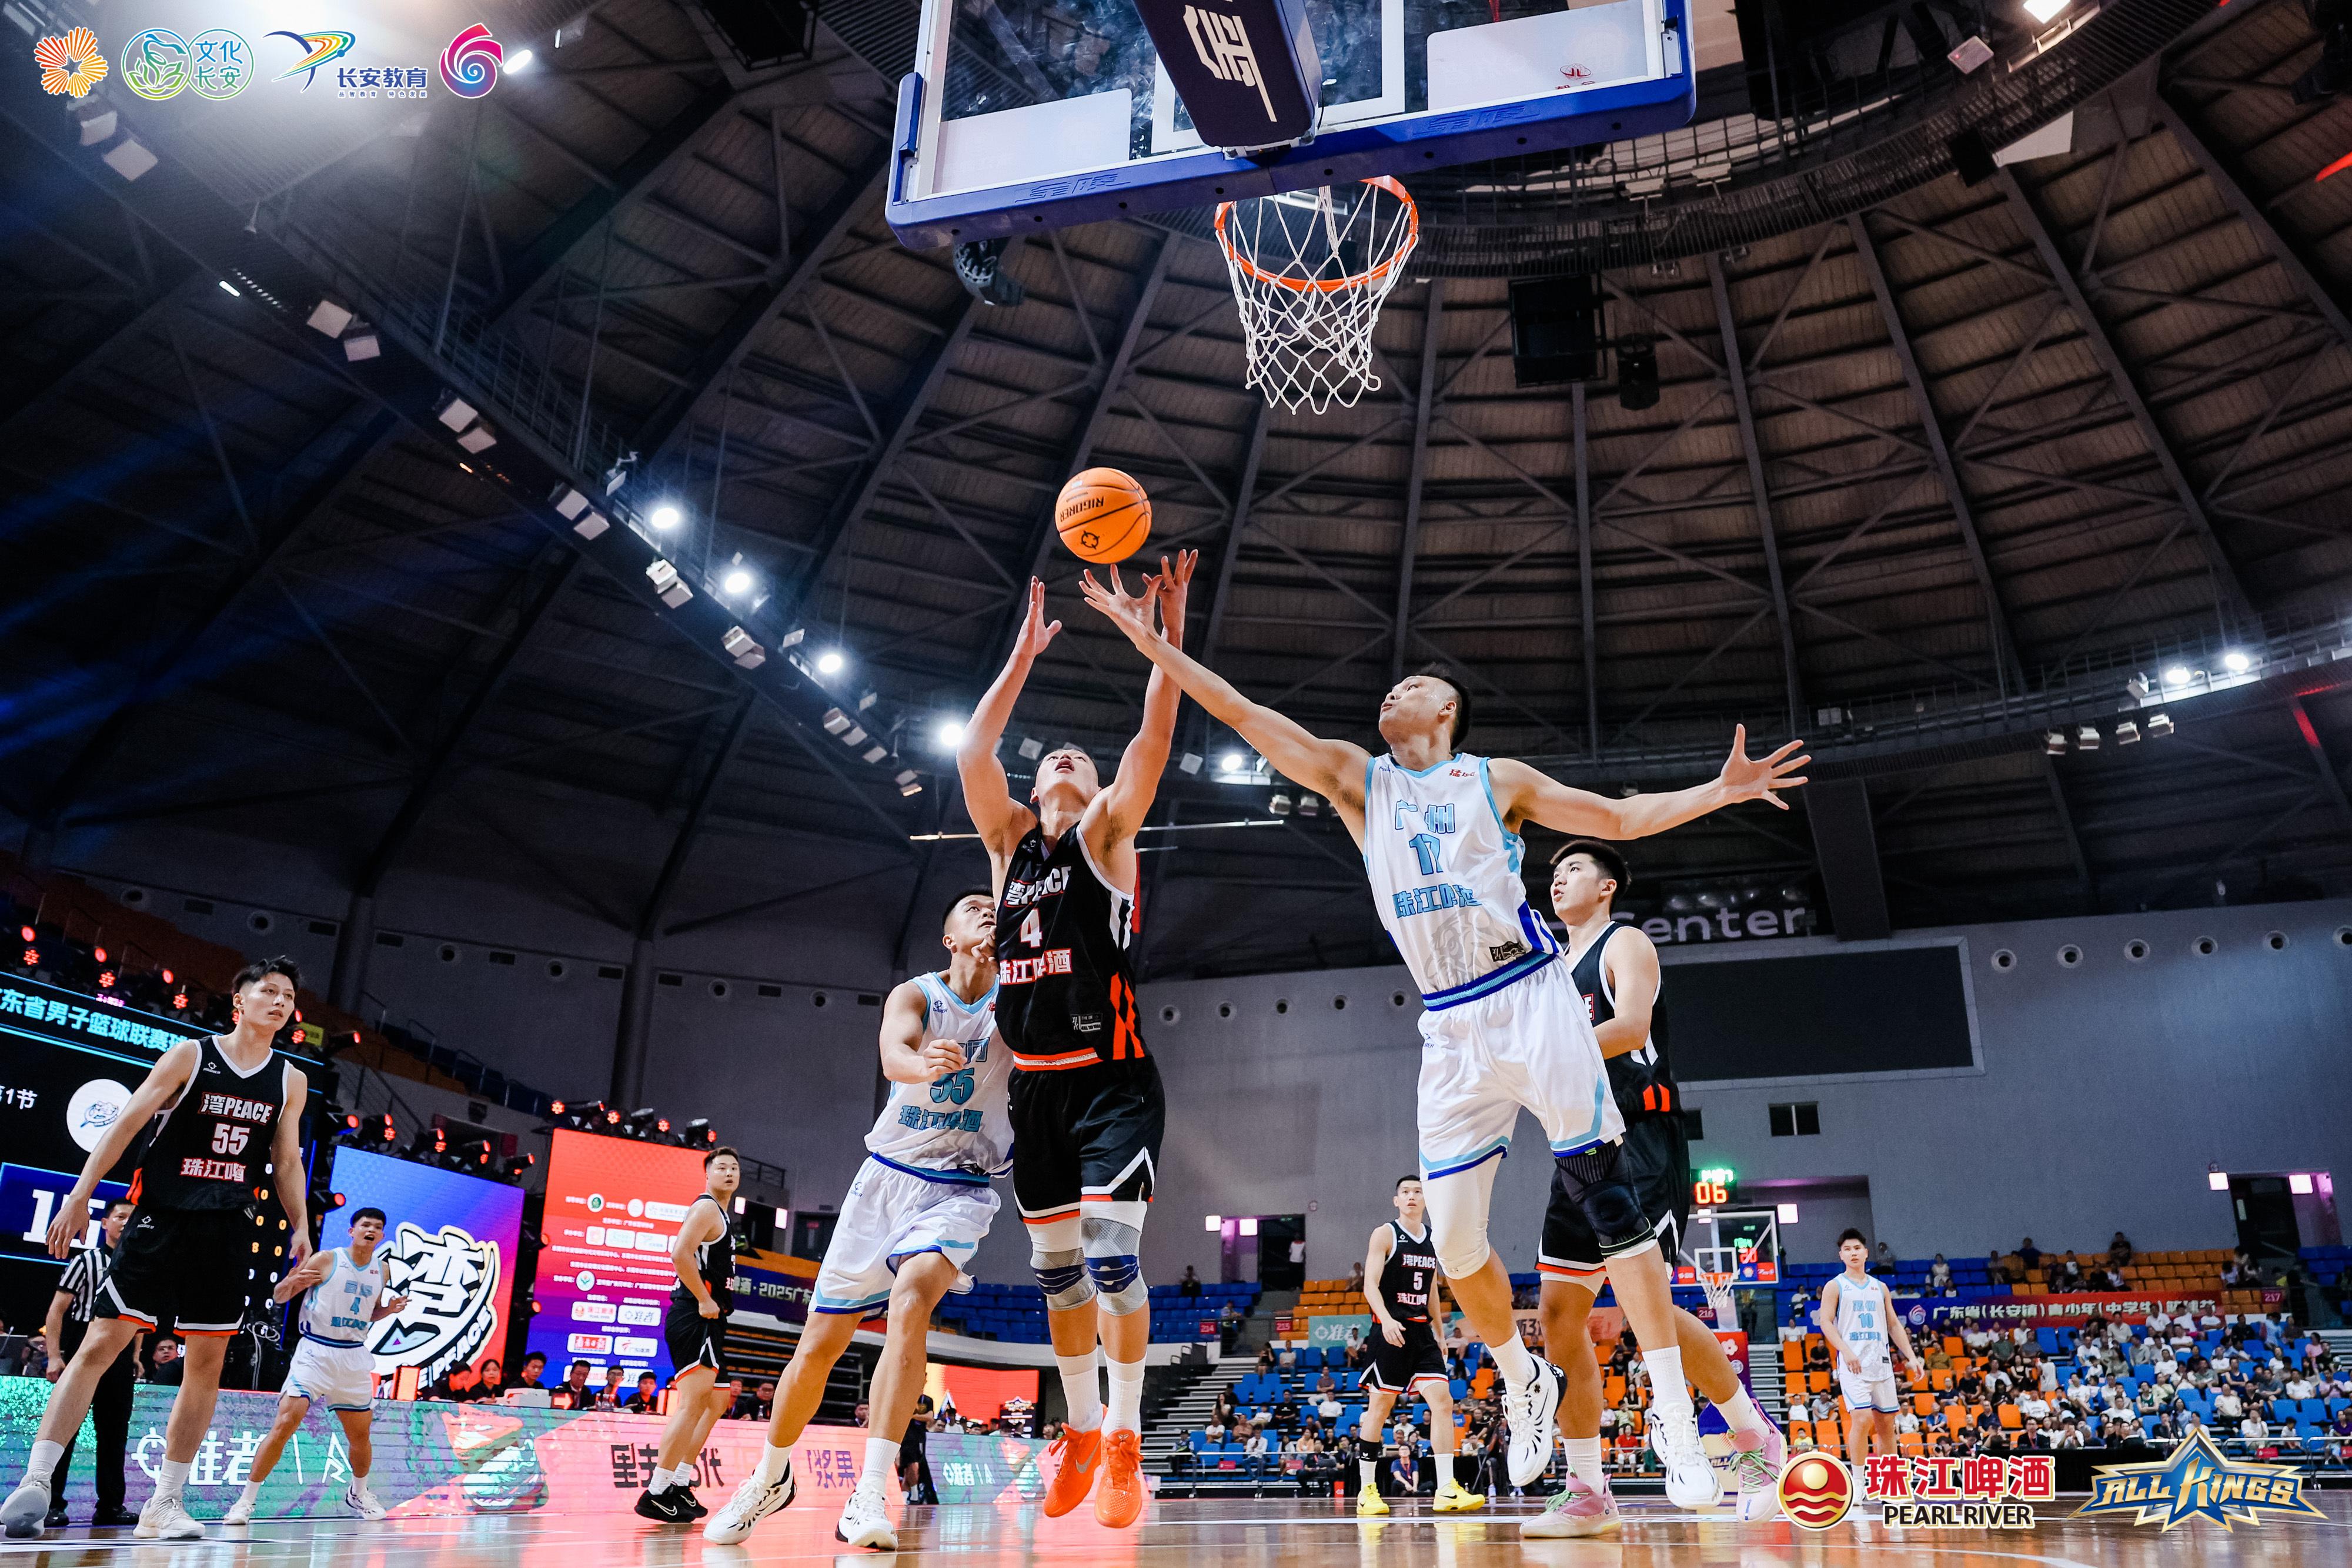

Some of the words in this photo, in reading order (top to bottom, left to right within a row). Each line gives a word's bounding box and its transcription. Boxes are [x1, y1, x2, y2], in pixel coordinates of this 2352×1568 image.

[1020, 908, 1043, 949] 4
[1610, 907, 1806, 944] enter
[0, 988, 189, 1053] 东省男子篮球联赛
[0, 1085, 38, 1110] 1节
[201, 1093, 274, 1124] 湾PEACE
[212, 1122, 250, 1155] 55
[1695, 1181, 1728, 1205] 06
[1402, 1254, 1436, 1269] 湾PEACE
[1413, 1271, 1423, 1290] 5
[2264, 1293, 2281, 1302] 217
[1698, 1309, 1714, 1319] 216
[1858, 1312, 1874, 1329] 10
[1200, 1323, 1215, 1332] 214
[1275, 1322, 1291, 1330] 215
